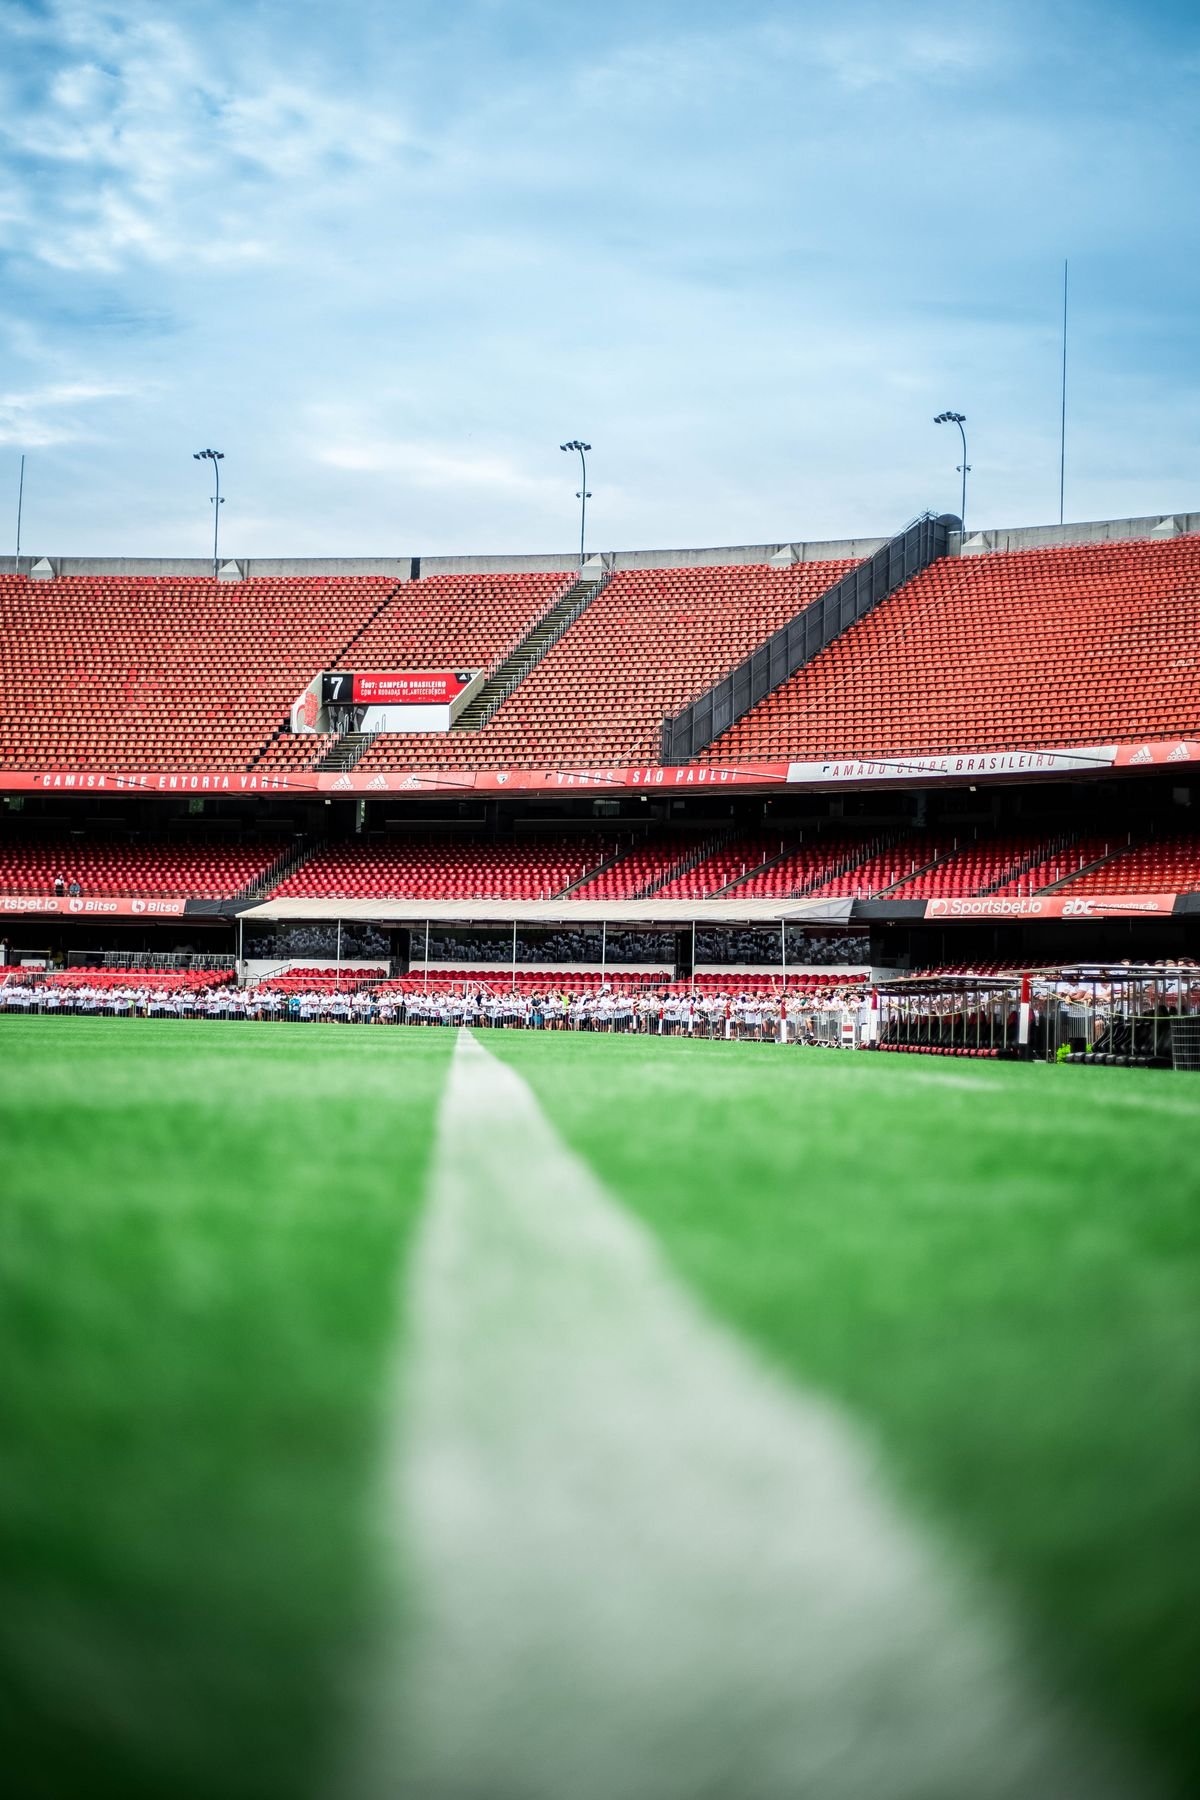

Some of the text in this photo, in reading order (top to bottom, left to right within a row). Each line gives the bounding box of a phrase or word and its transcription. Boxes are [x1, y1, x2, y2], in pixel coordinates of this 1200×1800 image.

[331, 677, 343, 700] 7
[379, 680, 408, 688] CAMPEÃO
[832, 764, 886, 777] AMADO
[955, 755, 1056, 771] BRASILEIRO
[43, 775, 290, 789] CAMISA QUE ENTORTA VARAL
[556, 771, 614, 785] VAMOS
[632, 767, 664, 784] SÃO
[85, 901, 118, 912] Bitso
[147, 902, 180, 913] Bitso
[950, 899, 1042, 915] Sportsbet.io
[1062, 898, 1095, 915] abc
